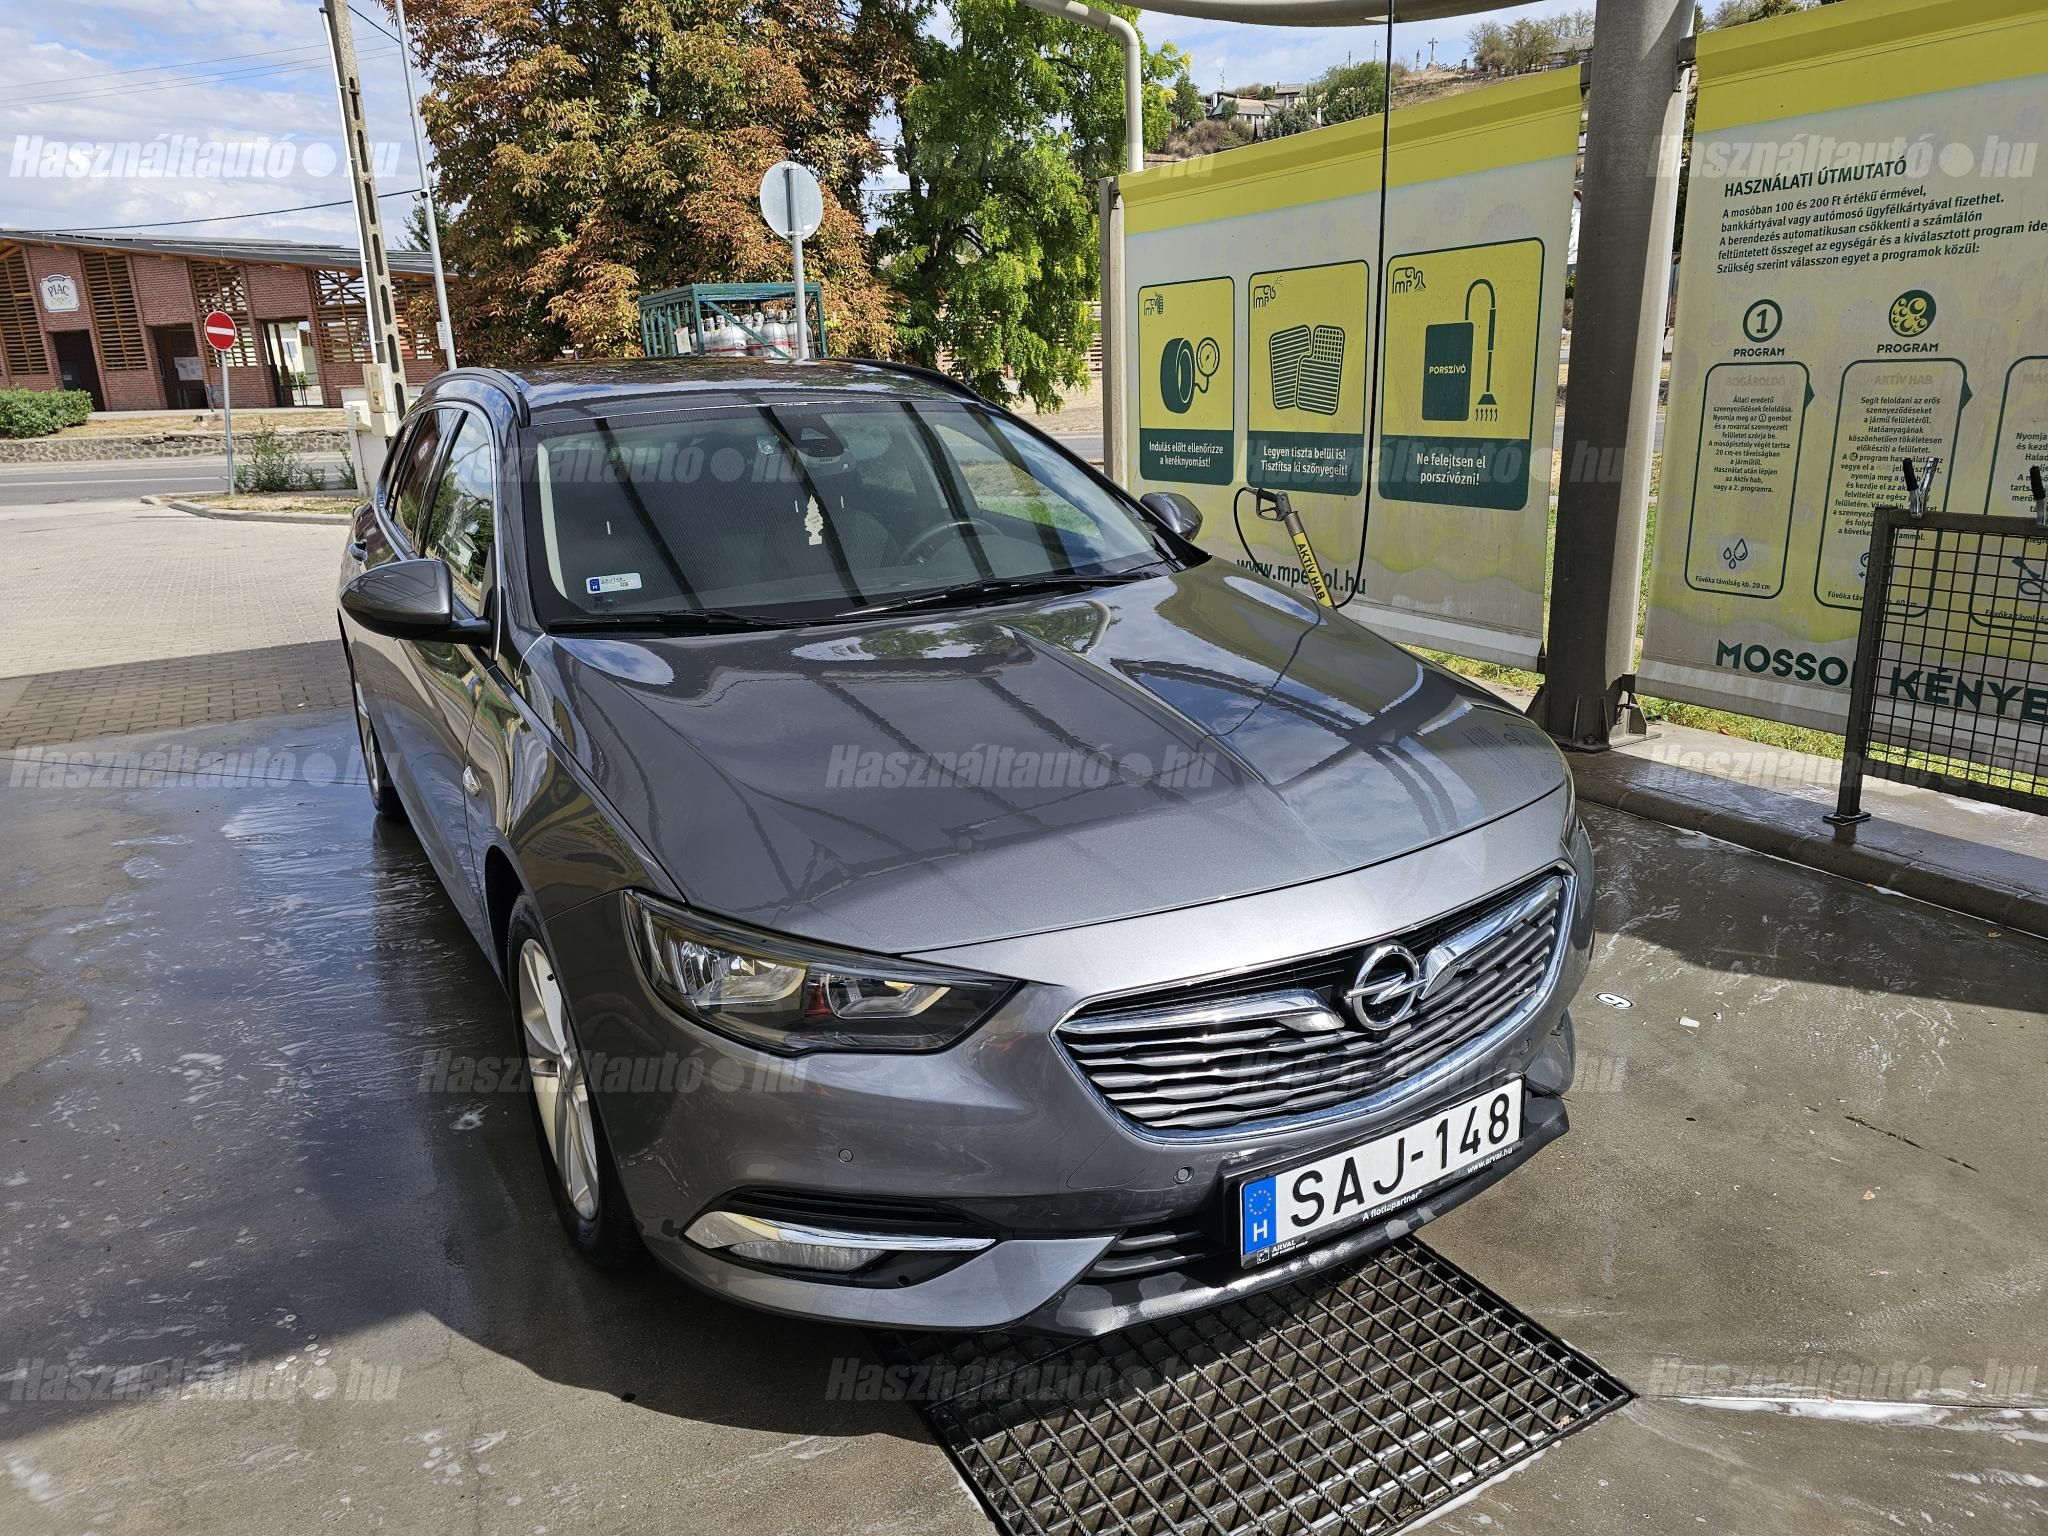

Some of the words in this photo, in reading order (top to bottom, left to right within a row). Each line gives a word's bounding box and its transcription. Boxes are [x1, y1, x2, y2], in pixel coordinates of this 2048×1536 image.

[1724, 172, 1814, 198] HASZNÁLATI
[1817, 155, 1907, 186] ÚTMUTATÓ
[1722, 209, 1729, 219] A
[1731, 205, 1772, 218] mosóban
[1775, 201, 1794, 213] 100
[1796, 199, 1807, 210] és
[1810, 197, 1829, 209] 200
[1832, 195, 1841, 206] Ft
[1843, 190, 1876, 204] értékű
[1880, 185, 1926, 201] érmével,
[1721, 216, 1786, 232] bankkártyával
[1788, 215, 1811, 225] vagy
[1813, 206, 1863, 223] autómosó
[1866, 197, 1952, 218] ügyfélkártyával
[1954, 193, 2004, 208] fizethet.
[1719, 237, 1726, 246] A
[1728, 231, 1780, 246] berendezés
[1782, 224, 1856, 240] automatikusan
[1859, 217, 1910, 232] csökkenti
[1913, 219, 1920, 228] a
[1922, 211, 1982, 227] számlálón
[1718, 247, 1768, 260] feltüntetett
[1771, 243, 1813, 256] összeget
[1815, 243, 1827, 251] az
[1829, 235, 1876, 252] egységár
[1879, 236, 1891, 246] és
[1894, 236, 1901, 244] a
[1903, 228, 1970, 244] kiválasztott
[1973, 224, 2025, 239] program
[2028, 219, 2048, 233] ide
[1716, 262, 1754, 274] Szükség
[1756, 259, 1788, 270] szerint
[1790, 254, 1839, 268] válasszon
[1841, 252, 1870, 266] egyet
[1872, 253, 1879, 261] a
[1881, 246, 1941, 262] programok
[1944, 242, 1980, 256] közül:
[47, 284, 70, 297] PIAC
[1734, 347, 1785, 358] PROGRAM
[1877, 342, 1939, 353] PROGRAM
[1429, 363, 1467, 374] PORSZÍVÓ
[1909, 375, 1933, 385] HAB
[1733, 395, 1749, 403] Állati
[1861, 397, 1879, 405] Segít
[1924, 396, 1941, 404] erős
[1713, 406, 1761, 415] szennyeződések
[1866, 407, 1932, 415] szennyeződéseket
[1713, 414, 1734, 422] Nyomja
[1768, 415, 1791, 423] gombot
[1869, 417, 1890, 425] jármű
[1891, 416, 1931, 424] felületéről.
[1868, 426, 1924, 435] Hatóanyagának
[1848, 435, 1898, 443] köszönhetően
[1899, 436, 1942, 444] tökéletesen
[2016, 432, 2048, 442] Nyomja
[1149, 441, 1171, 452] Indulás
[1172, 442, 1187, 452] előtt
[1188, 442, 1224, 454] ellenőrizze
[1714, 440, 1752, 448] mosópisztoly
[1857, 444, 1890, 452] előkészíti
[2017, 442, 2026, 450] és
[1263, 446, 1290, 460] Legyen
[1291, 447, 1313, 459] tiszta
[1314, 447, 1334, 460] belül
[1336, 449, 1346, 460] is!
[1743, 450, 1780, 458] távolságban
[1165, 455, 1211, 468] keréknyomást!
[1416, 452, 1429, 465] Ne
[1431, 453, 1473, 469] felejtsen
[1476, 455, 1486, 468] el
[1859, 455, 1889, 463] program
[1261, 459, 1291, 472] Tisztítsa
[1293, 462, 1301, 473] ki
[1302, 462, 1348, 478] szőnyegeit!
[1714, 466, 1743, 474] Használat
[1759, 467, 1778, 476] lépjen
[1841, 463, 1860, 471] vegye
[1420, 471, 1480, 486] porszívózni!
[1851, 473, 1875, 481] nyomja
[2017, 473, 2024, 481] A
[1856, 482, 1878, 490] kezdje
[1844, 491, 1874, 499] felvitelét
[1835, 499, 1870, 508] felületére.
[1237, 558, 1366, 595] www.mpeol.hu
[1298, 543, 1316, 574] AKTÍV
[1311, 576, 1326, 600] HAB
[1716, 578, 1741, 589] távolság
[1742, 580, 1751, 588] kb.
[1716, 639, 1857, 691] MOSSO
[1253, 1219, 1268, 1243] H
[1290, 1093, 1510, 1228] SAJ-148
[1272, 1240, 1296, 1253] ARVAL
